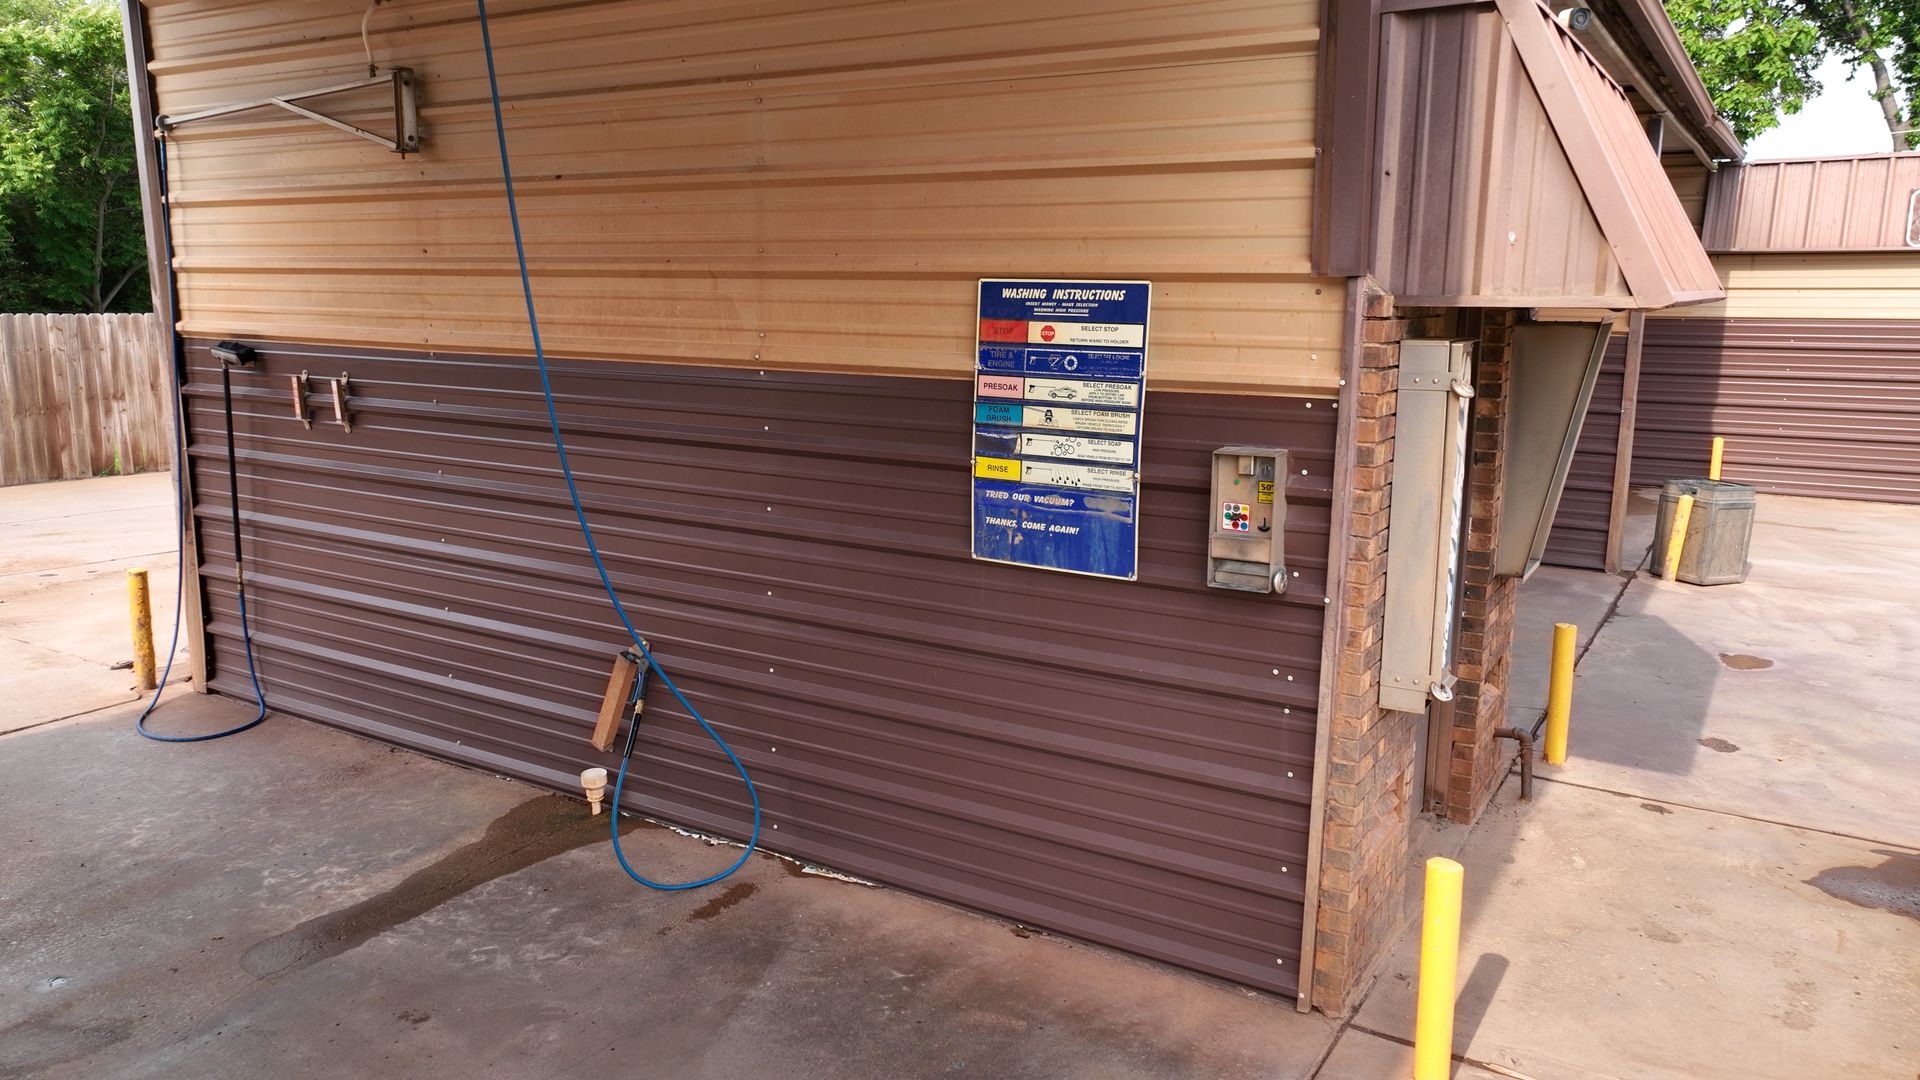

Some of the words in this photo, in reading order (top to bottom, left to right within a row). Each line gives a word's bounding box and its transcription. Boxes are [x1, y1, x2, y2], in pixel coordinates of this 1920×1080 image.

[1002, 288, 1047, 299] WASHING
[1052, 289, 1126, 301] INSTRUCTIONS
[988, 360, 1016, 369] ENGINE
[983, 382, 1018, 392] PRESOAK
[988, 405, 1010, 414] FOAM
[986, 414, 1012, 424] BRUSH
[987, 464, 1008, 473] RINSE
[985, 489, 1009, 499] TRIED
[1012, 493, 1031, 502] OUR
[1034, 495, 1075, 507] VACUUM?
[985, 516, 1018, 528] THANKS,
[1022, 521, 1046, 531] COME
[1048, 524, 1080, 535] AGAIN!
